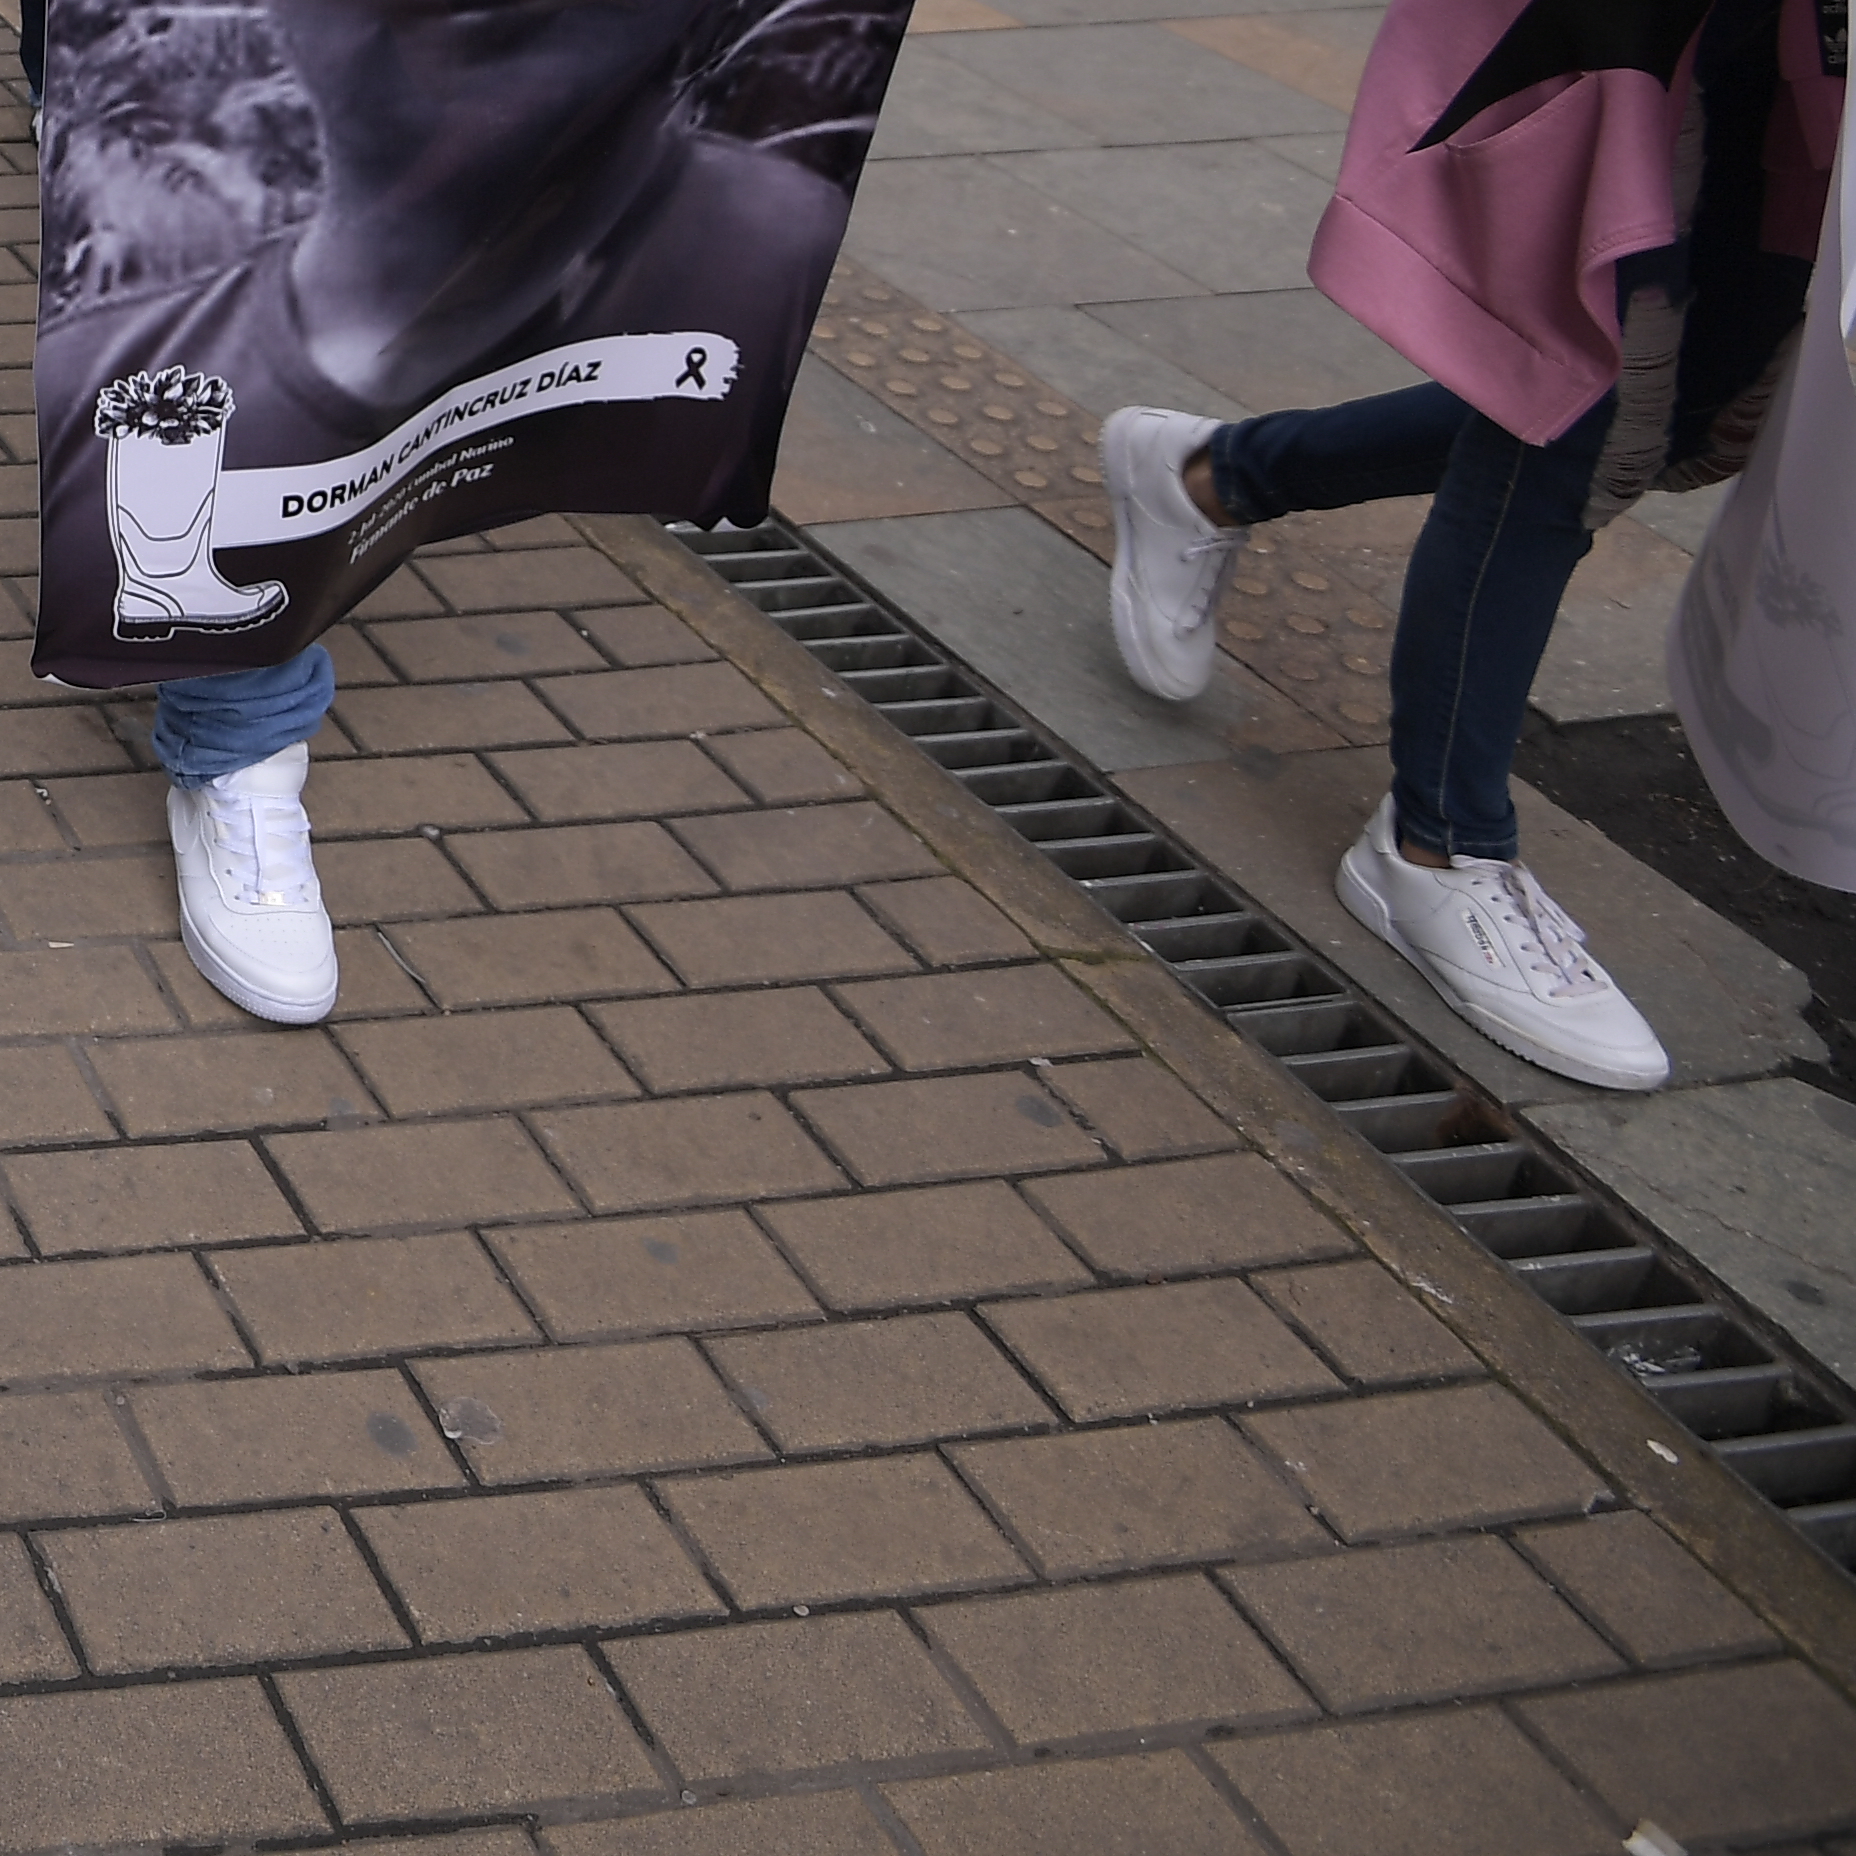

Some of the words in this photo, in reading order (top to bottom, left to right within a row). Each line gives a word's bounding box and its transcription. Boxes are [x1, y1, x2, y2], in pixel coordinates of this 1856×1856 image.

[281, 455, 395, 519] DORMAN
[396, 378, 532, 466] CANTINCRUZ
[534, 358, 604, 394] DÍAZ
[349, 495, 420, 565] Firmante
[421, 479, 448, 502] de
[449, 461, 495, 489] Paz
